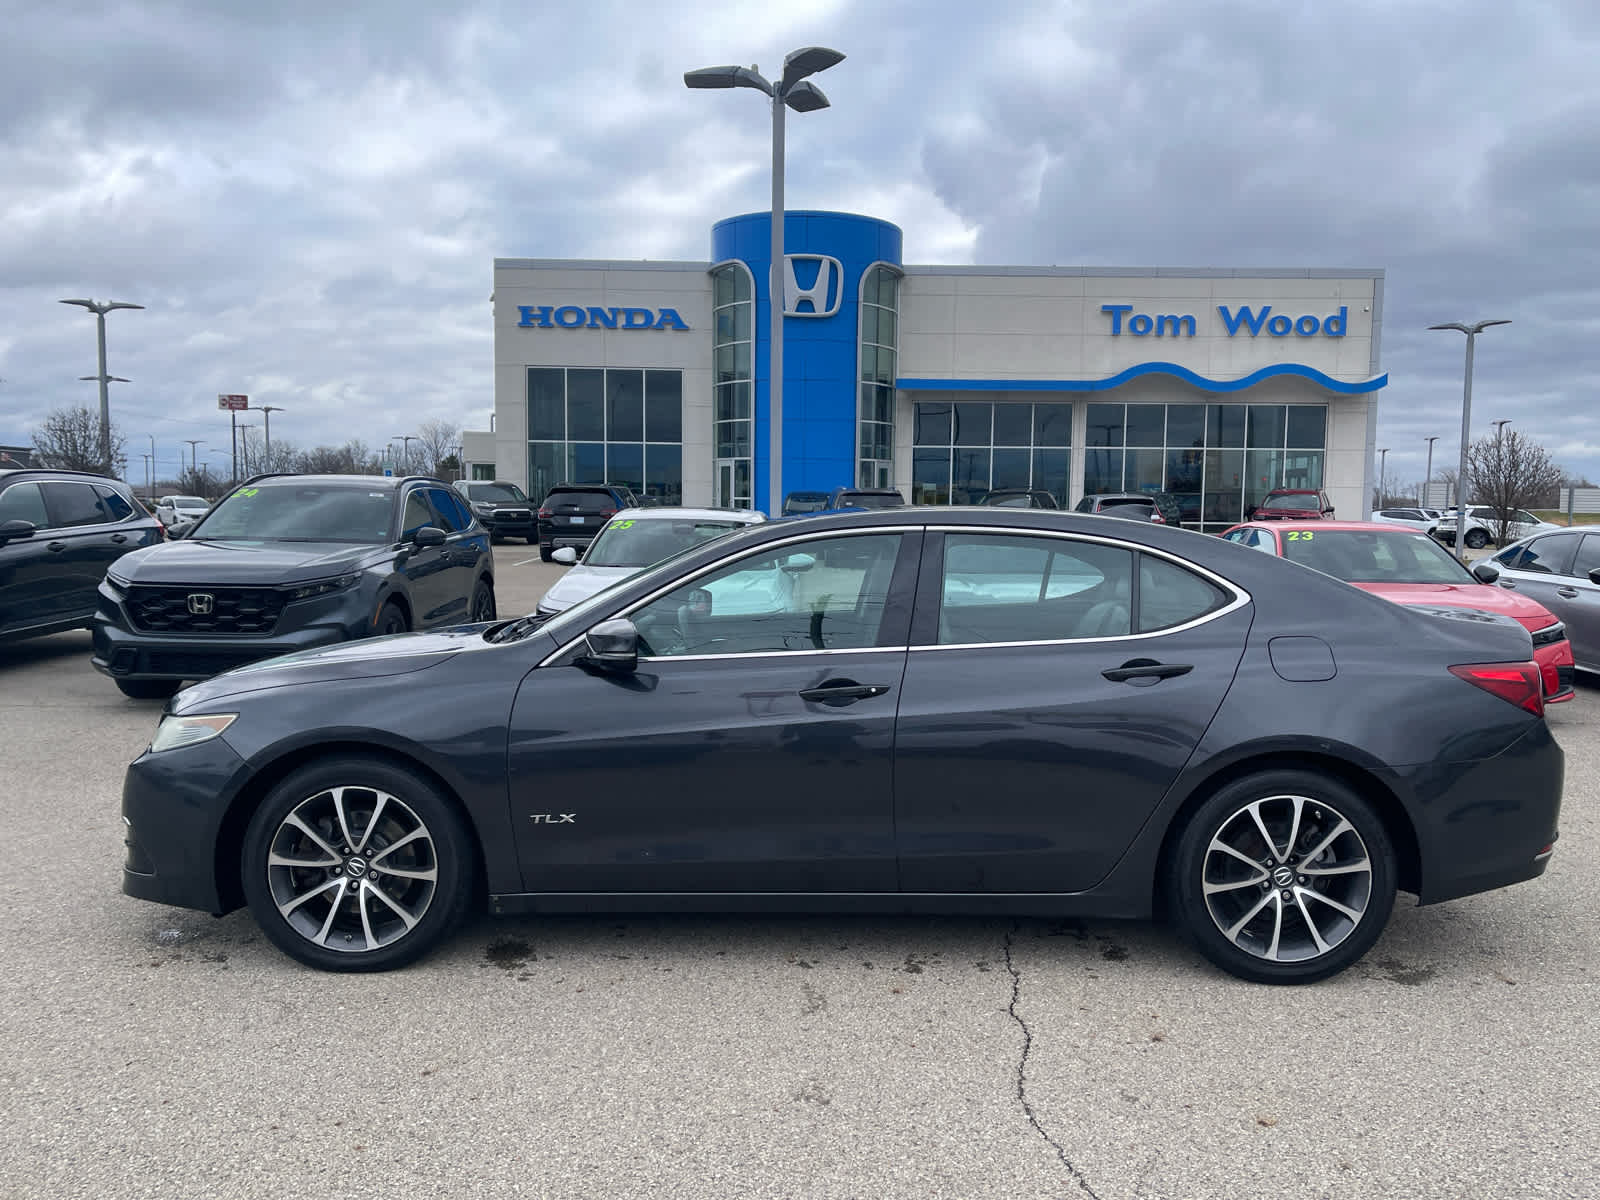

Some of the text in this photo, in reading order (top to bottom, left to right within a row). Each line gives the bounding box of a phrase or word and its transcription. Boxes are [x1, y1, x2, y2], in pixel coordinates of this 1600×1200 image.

[517, 305, 690, 330] HONDA
[1101, 305, 1349, 337] Tom Wood
[608, 519, 636, 529] 25
[1287, 531, 1314, 541] 23
[529, 813, 577, 824] TLX
